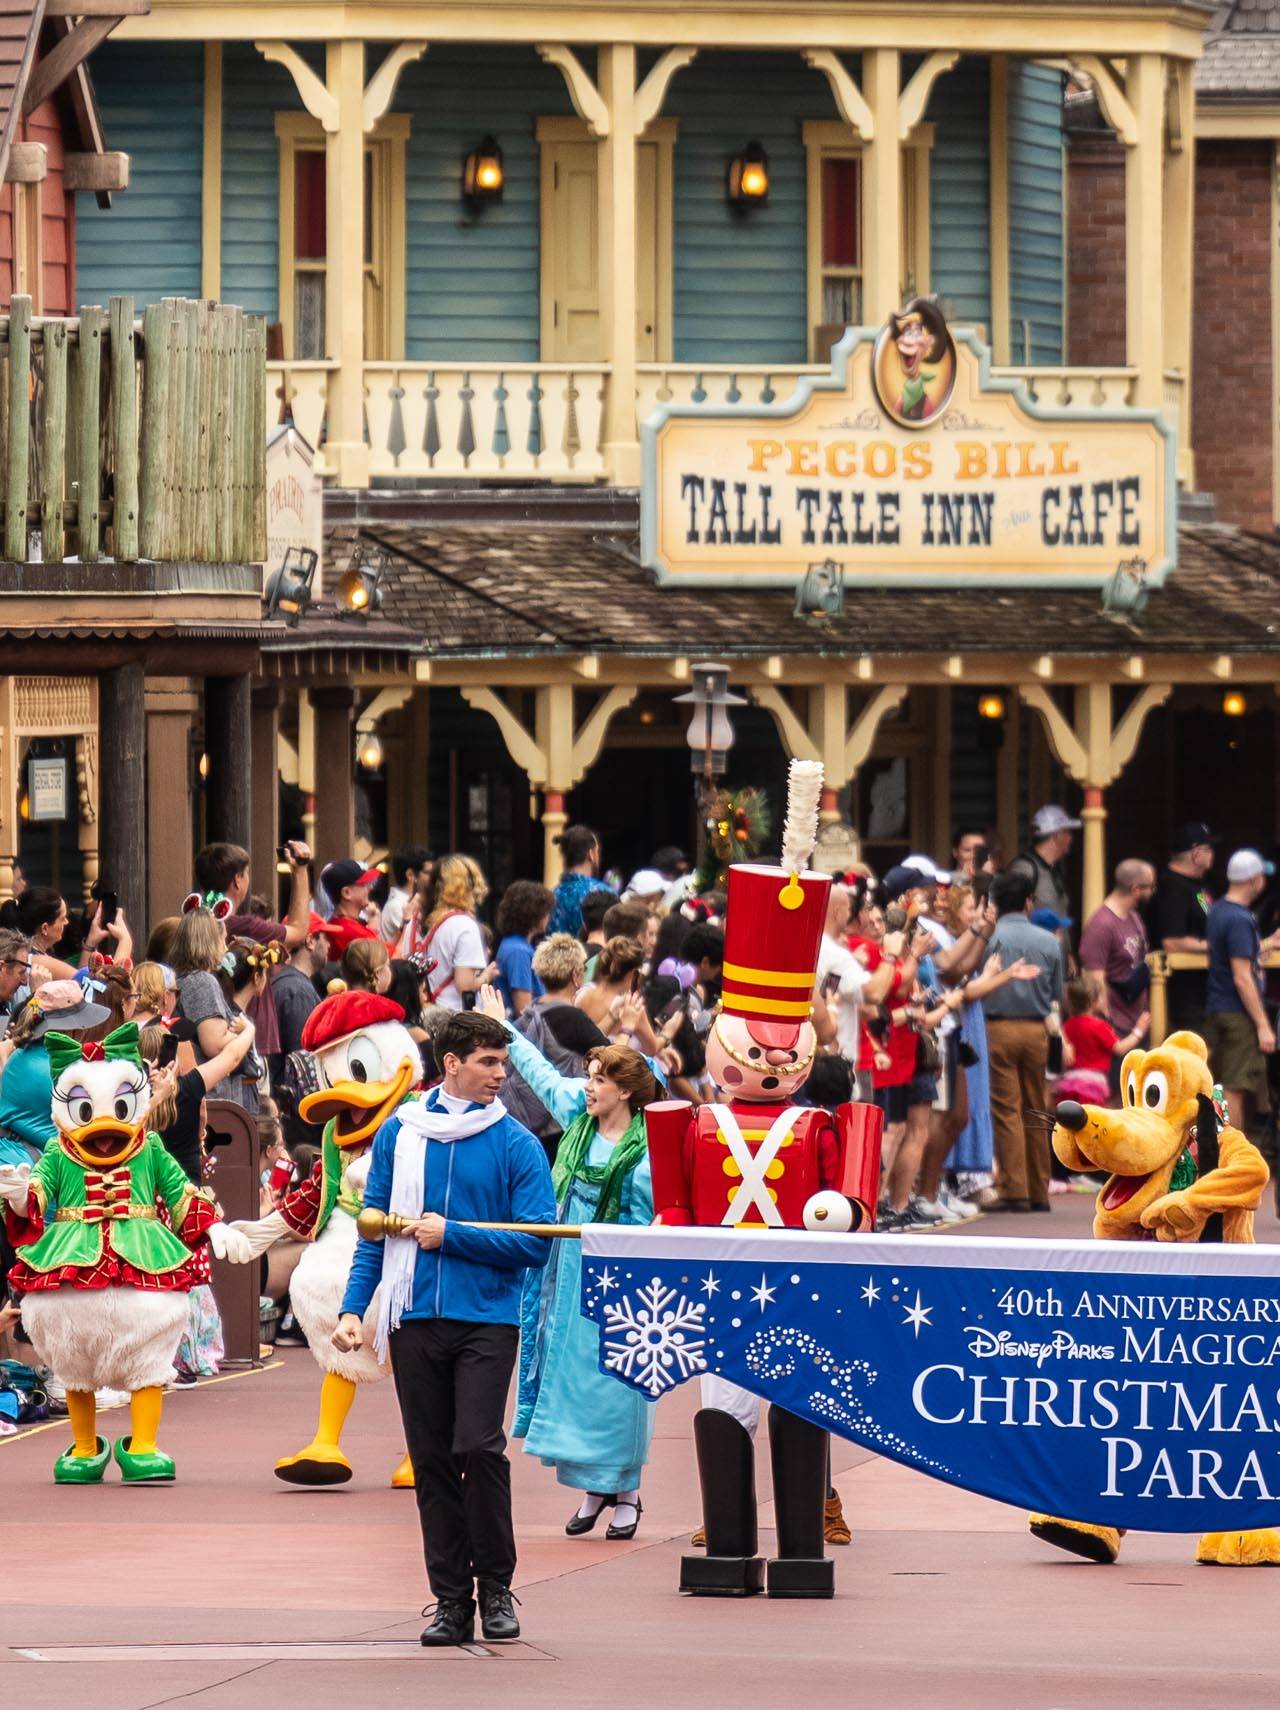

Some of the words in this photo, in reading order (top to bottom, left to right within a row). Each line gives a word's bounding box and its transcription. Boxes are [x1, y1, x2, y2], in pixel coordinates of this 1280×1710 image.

[747, 438, 933, 481] PECOS
[954, 440, 1079, 480] BILL
[681, 473, 781, 545] TALL
[797, 488, 900, 545] TALE
[922, 492, 995, 546] INN
[1040, 476, 1140, 546] CAFE
[997, 1286, 1064, 1317] 40th
